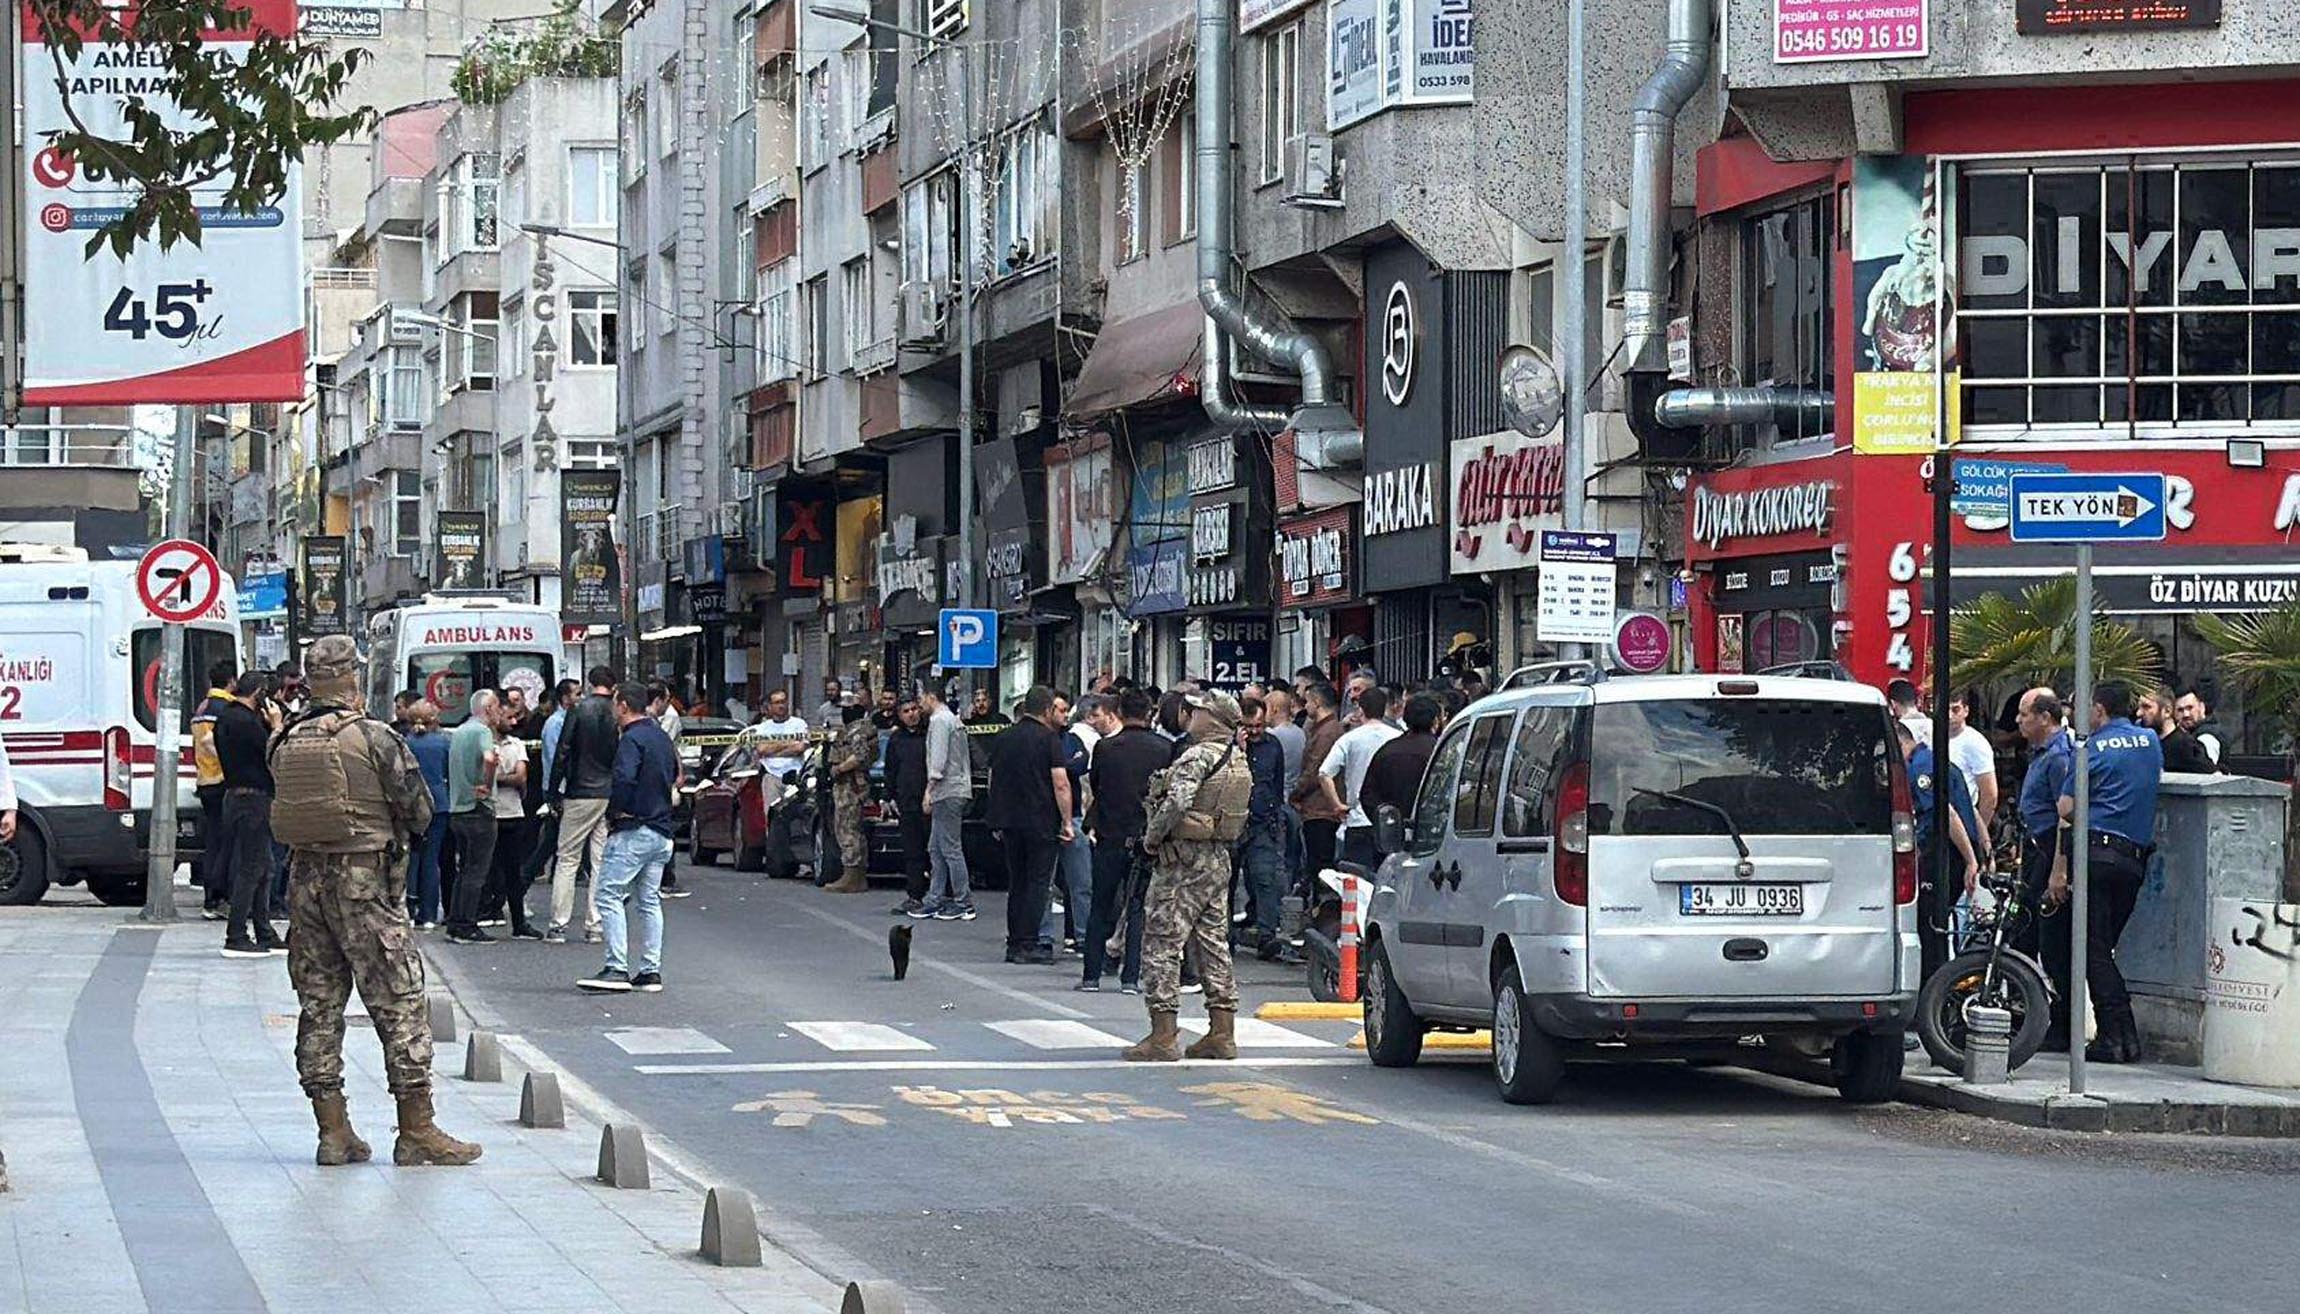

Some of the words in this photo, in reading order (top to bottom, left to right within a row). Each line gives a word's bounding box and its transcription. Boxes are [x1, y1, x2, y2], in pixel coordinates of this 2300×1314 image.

[1782, 29, 1826, 52] 0546
[1831, 27, 1864, 50] 509
[1868, 26, 1890, 48] 16
[1895, 24, 1917, 46] 19
[1419, 77, 1447, 88] 0533
[1450, 75, 1470, 86] 598
[1364, 463, 1433, 537] BARAKA
[2028, 499, 2064, 515] TEK
[2073, 496, 2114, 515] YÖN
[2150, 574, 2175, 603] ÖZ
[2180, 574, 2239, 603] DİYAR
[2244, 580, 2298, 603] KUZU
[424, 626, 534, 644] AMBULANS
[952, 615, 984, 661] P
[1213, 622, 1267, 641] SIFIR
[1215, 662, 1265, 683] 2.EL
[1693, 887, 1713, 906] 34
[1726, 887, 1745, 906] JU
[1757, 888, 1798, 908] 0936
